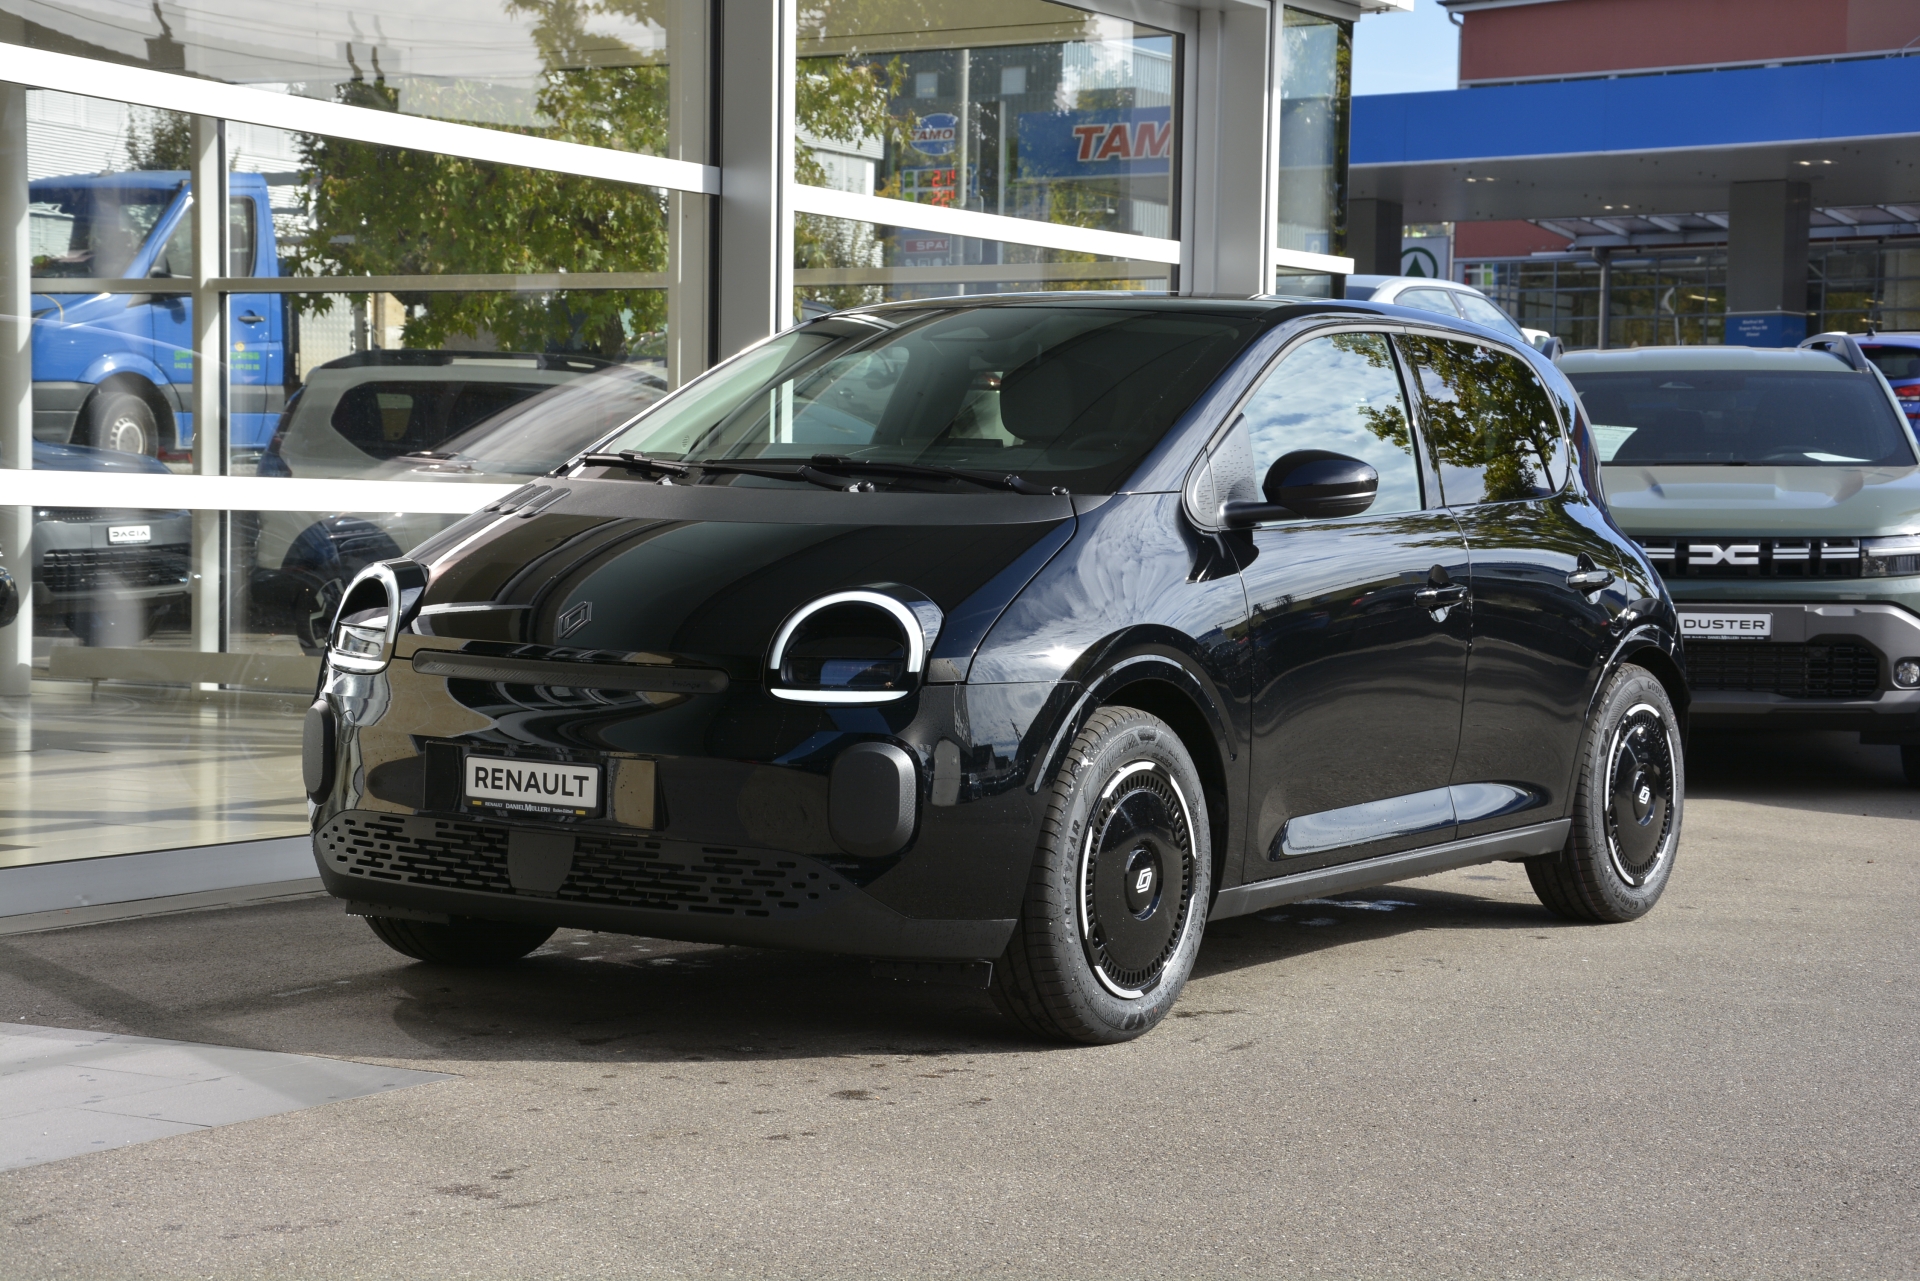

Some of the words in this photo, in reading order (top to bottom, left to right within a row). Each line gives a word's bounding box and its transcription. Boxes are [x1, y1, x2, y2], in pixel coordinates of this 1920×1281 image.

[911, 129, 953, 140] TAMO
[1683, 619, 1766, 630] DUSTER
[474, 766, 590, 798] RENAULT
